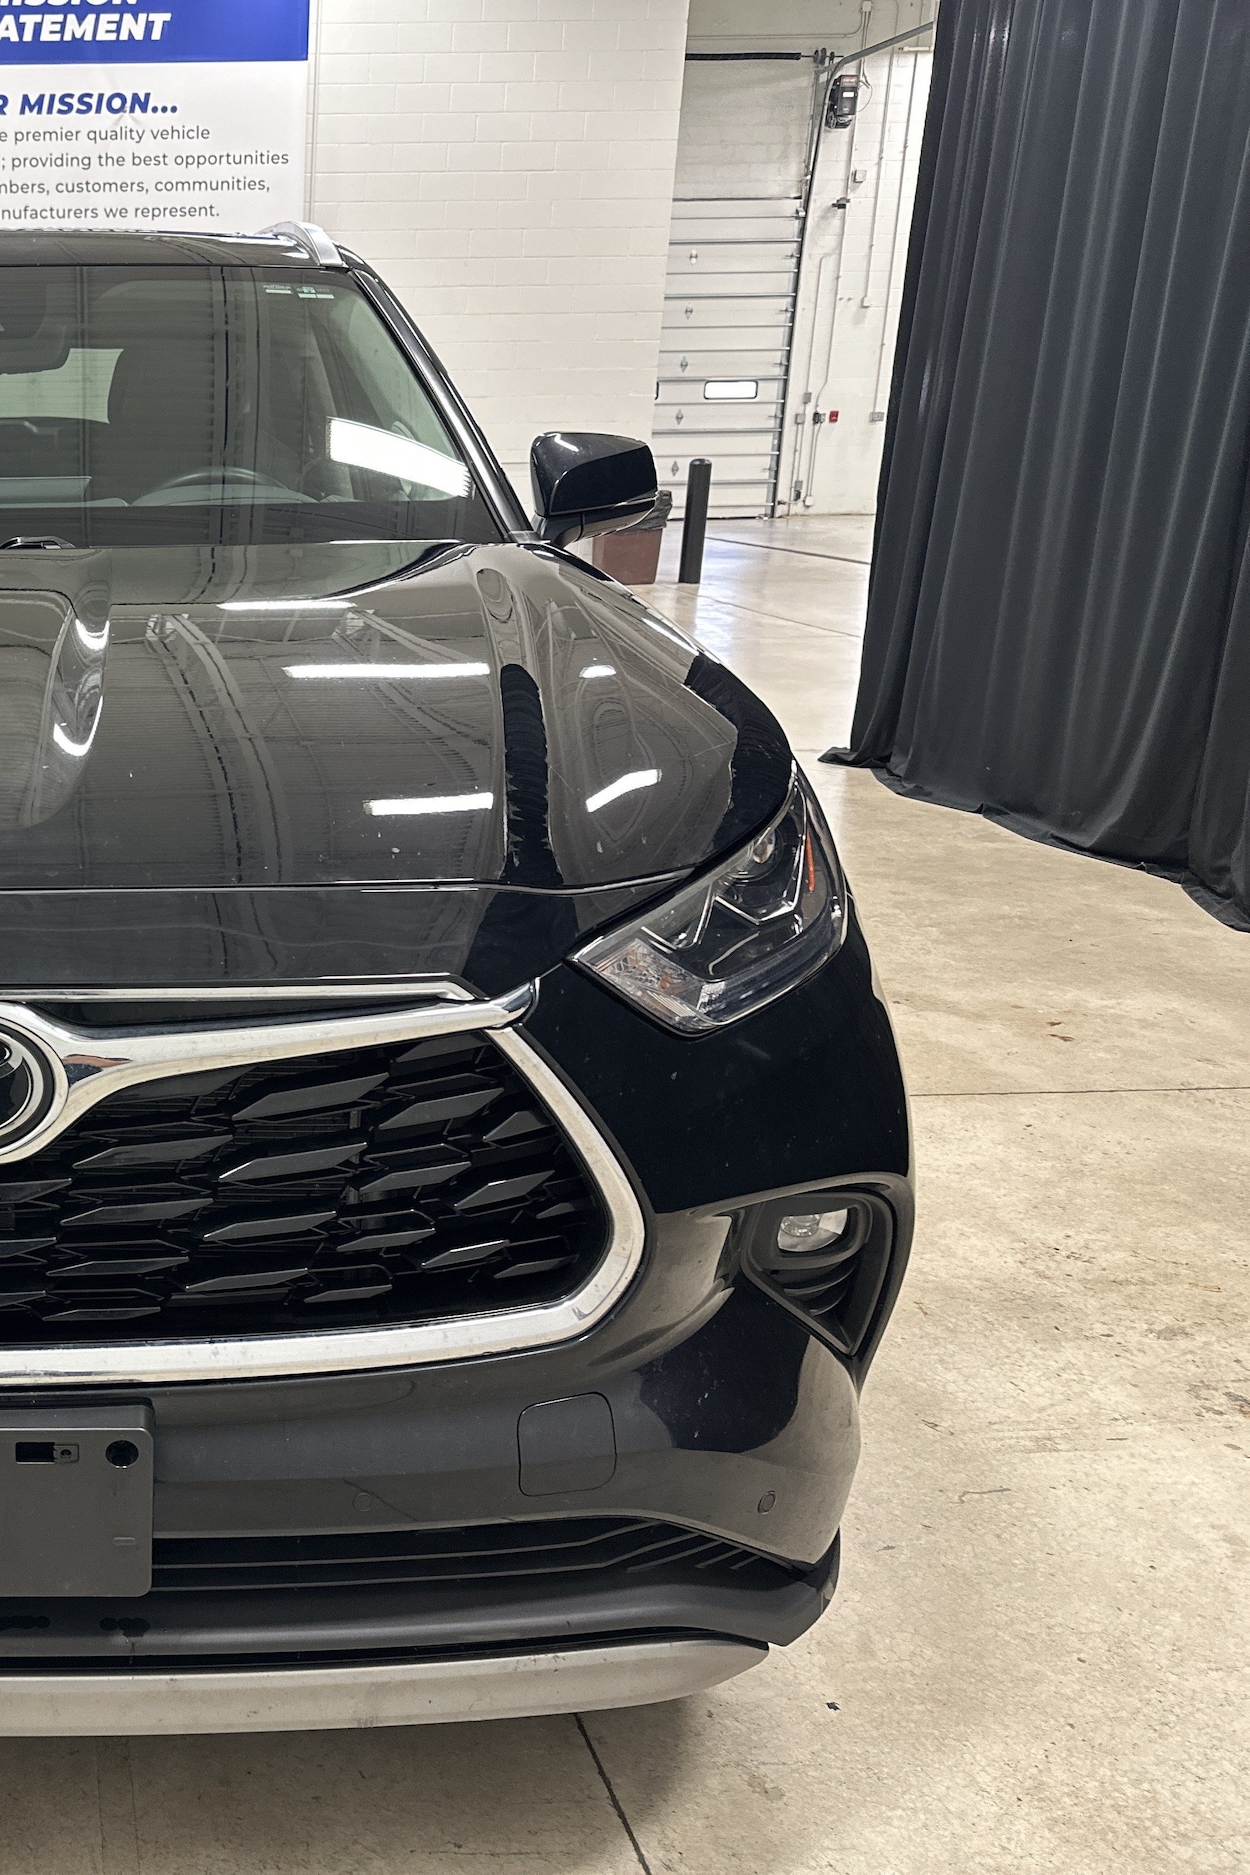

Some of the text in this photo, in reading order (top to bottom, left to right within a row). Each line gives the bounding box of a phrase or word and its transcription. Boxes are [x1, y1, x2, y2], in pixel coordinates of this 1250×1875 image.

[19, 92, 178, 116] MISSION...
[14, 126, 82, 146] premier
[86, 125, 146, 145] quality
[150, 124, 211, 140] vehicle
[11, 152, 92, 172] providing
[97, 152, 126, 167] the
[131, 151, 169, 167] best
[174, 149, 289, 169] opportunities
[55, 180, 149, 195] customers,
[154, 176, 270, 193] communities,
[103, 207, 129, 219] we
[134, 204, 220, 221] represent.
